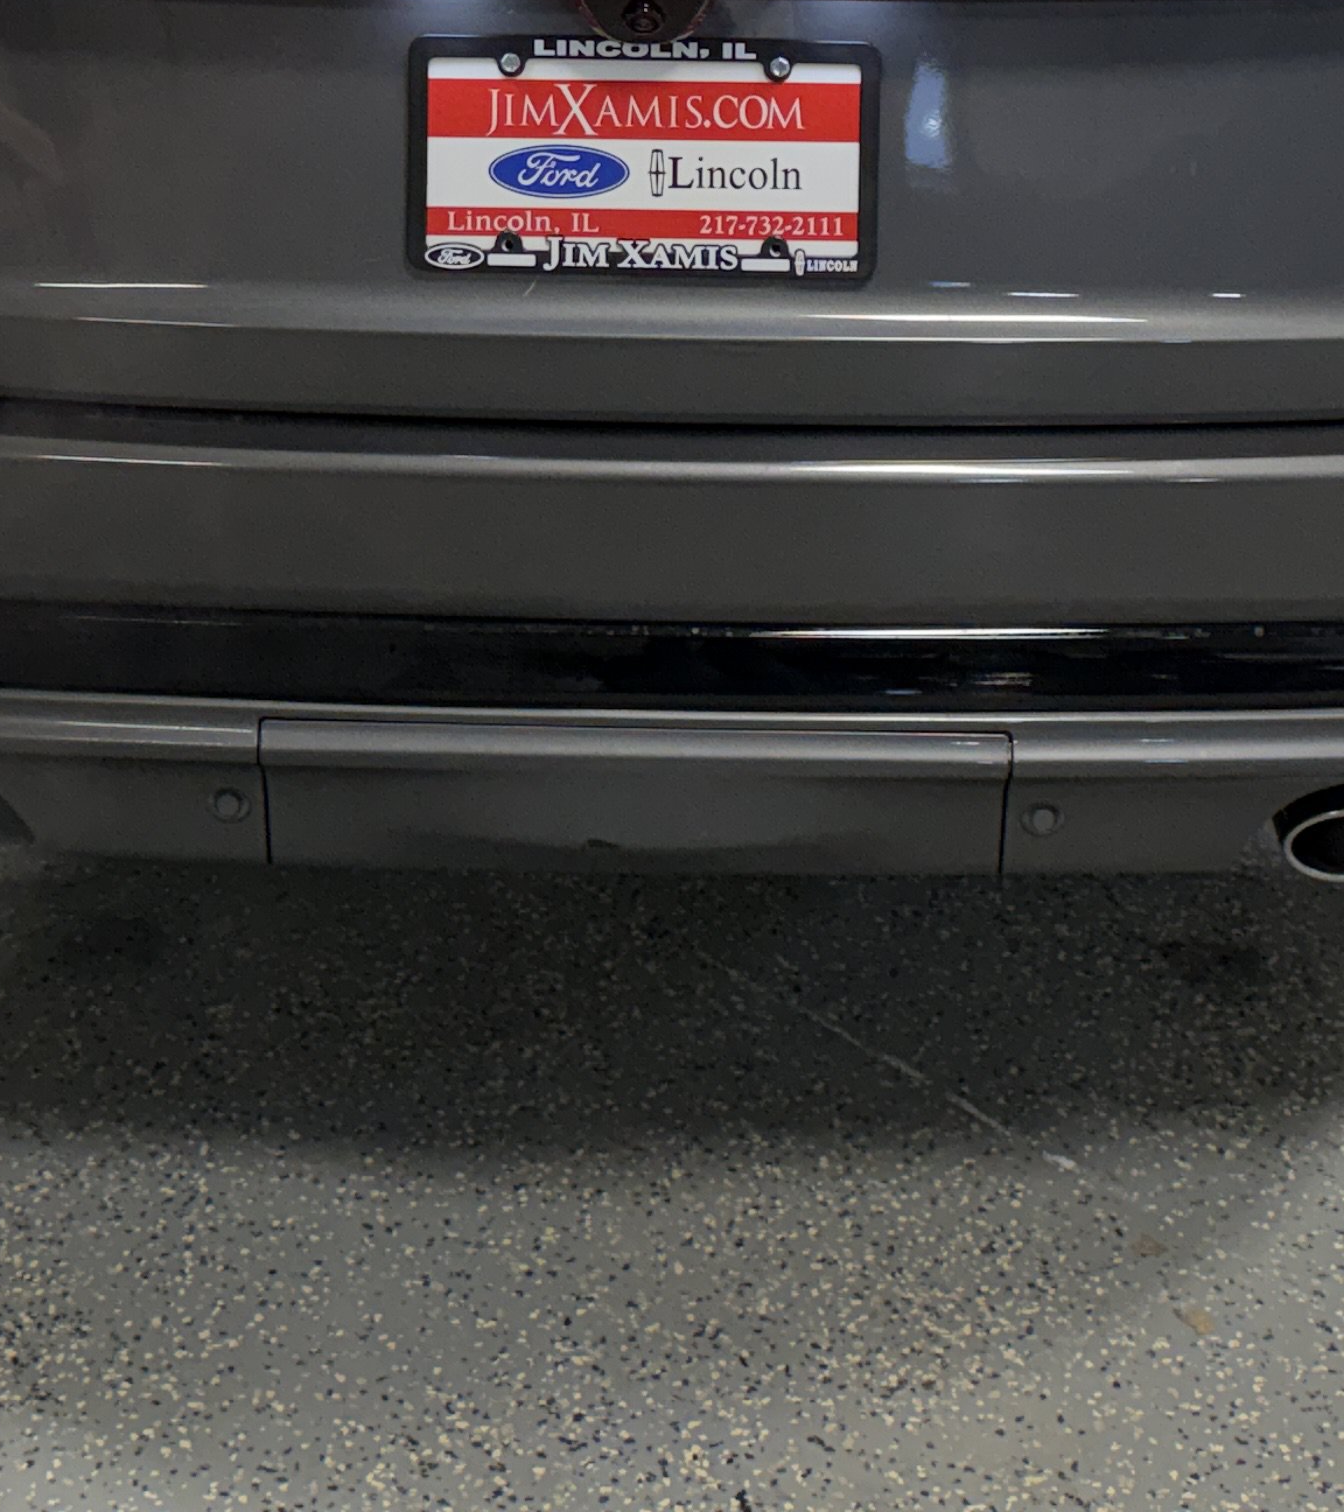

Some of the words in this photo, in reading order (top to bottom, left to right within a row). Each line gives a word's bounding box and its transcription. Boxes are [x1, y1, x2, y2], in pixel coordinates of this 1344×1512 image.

[533, 39, 710, 59] LINCOLN,
[722, 42, 756, 60] IL
[517, 151, 602, 189] Ford
[668, 157, 802, 190] Lincoln
[449, 211, 559, 233] Lincoln,
[571, 213, 599, 233] IL
[700, 216, 842, 238] 217-732-2111
[542, 236, 611, 271] JIM
[616, 239, 739, 271] XAMIS
[806, 259, 858, 273] LINCOLN
